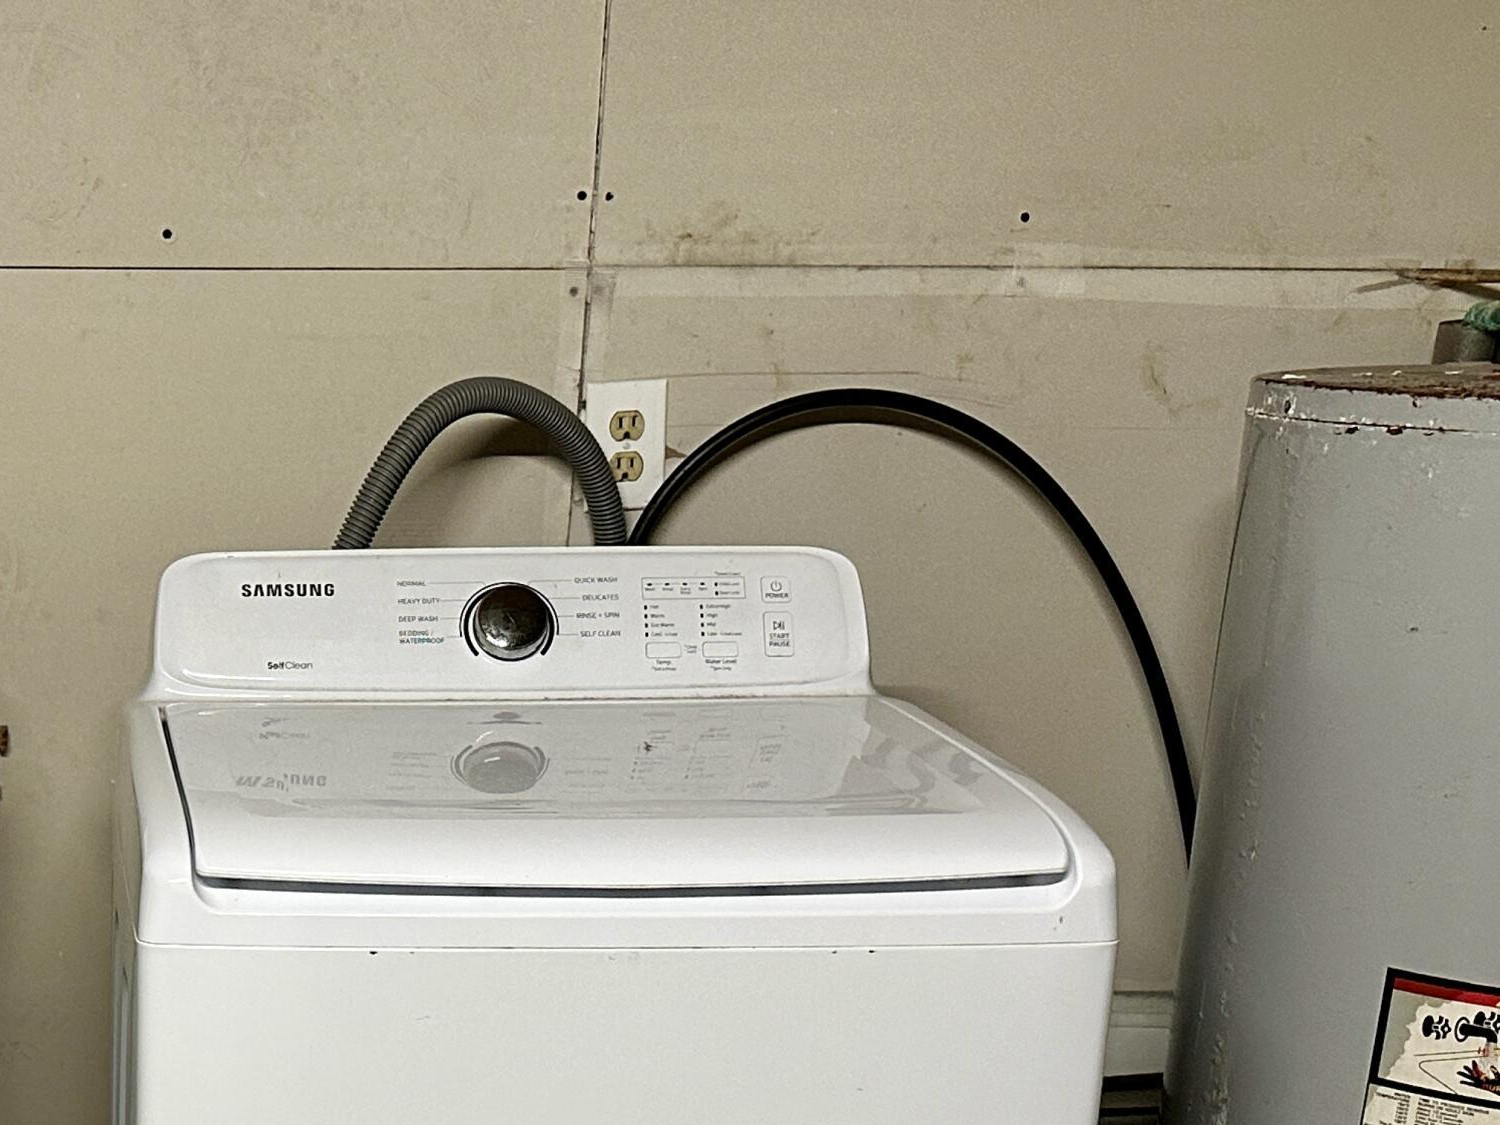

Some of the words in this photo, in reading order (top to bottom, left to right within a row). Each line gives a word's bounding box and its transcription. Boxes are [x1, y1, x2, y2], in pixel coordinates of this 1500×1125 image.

[596, 576, 619, 584] WASH
[240, 583, 336, 598] SAMSUNG
[421, 597, 441, 605] DUTY
[581, 593, 620, 601] DELICATES
[398, 615, 417, 623] DEEP
[417, 615, 439, 623] WASH
[769, 632, 790, 640] START
[399, 637, 445, 645] WATERPROOF
[769, 640, 790, 648] PAUSE
